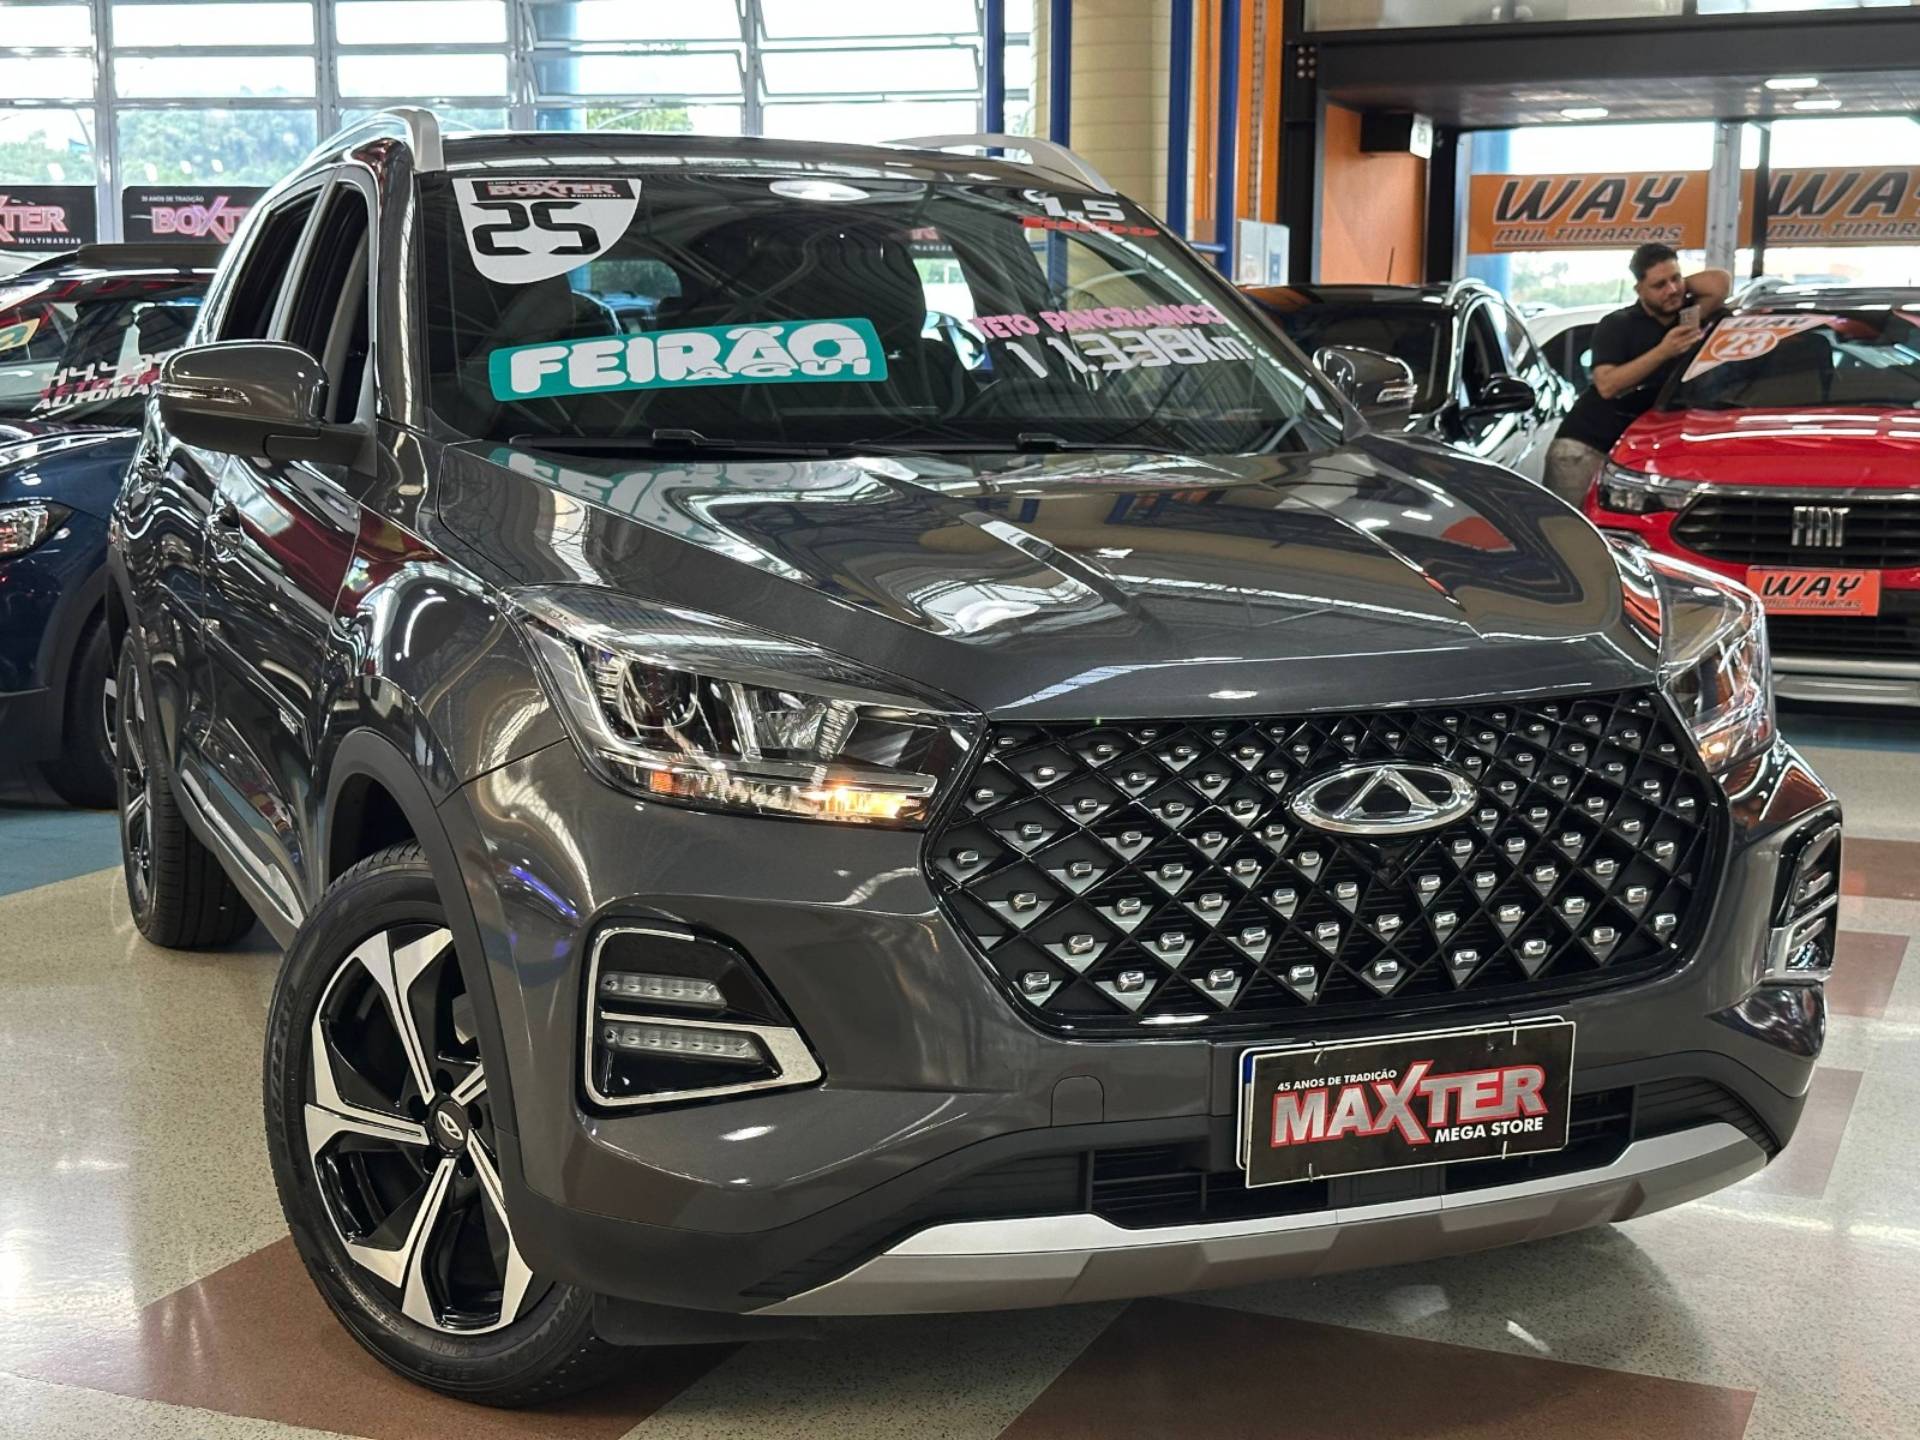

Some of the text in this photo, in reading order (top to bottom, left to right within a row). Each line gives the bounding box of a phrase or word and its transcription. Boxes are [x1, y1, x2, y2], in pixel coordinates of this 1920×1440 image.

[487, 180, 617, 198] BOXTER
[1494, 175, 1687, 224] WAY
[1768, 171, 1920, 218] WA
[470, 202, 602, 256] 25
[969, 314, 1040, 339] TETO
[510, 323, 868, 393] FEIRÃO
[1716, 331, 1771, 358] 23
[1791, 505, 1851, 548] FIAT
[1761, 574, 1863, 598] WAY
[1277, 1068, 1398, 1091] 45 ANOS DE TRADIÇÃO
[1270, 1059, 1549, 1148] MAXTER
[1434, 1116, 1544, 1144] MEGA STORE
